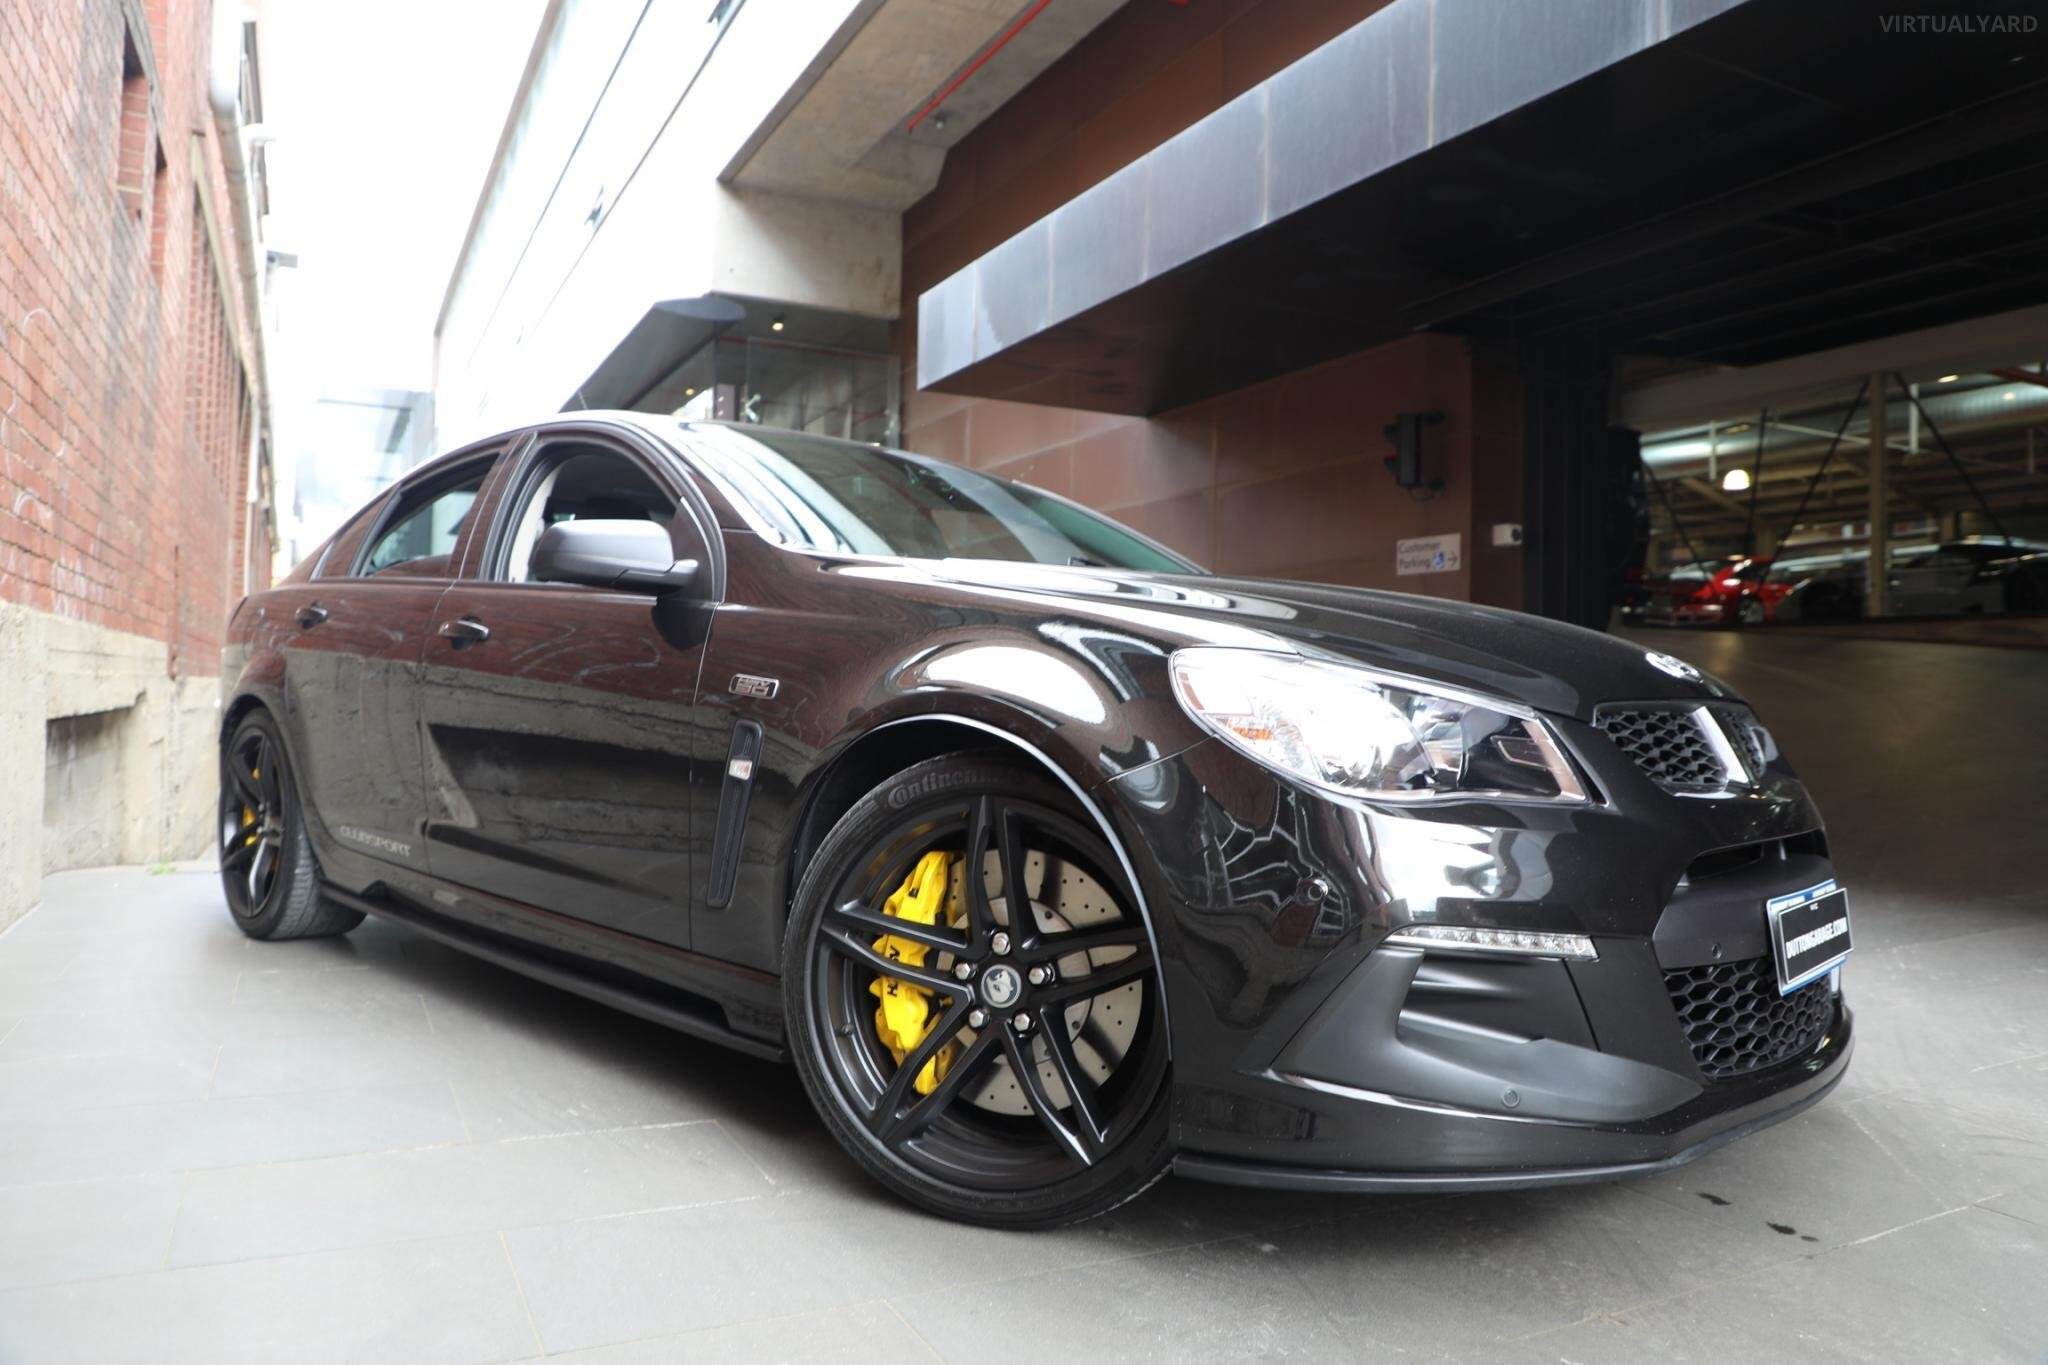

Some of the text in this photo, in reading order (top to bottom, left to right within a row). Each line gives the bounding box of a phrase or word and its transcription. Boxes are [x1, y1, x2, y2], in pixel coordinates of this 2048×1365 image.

[1398, 541, 1440, 554] Customer
[1399, 558, 1431, 570] Parking
[340, 825, 411, 857] CLUBSPORT
